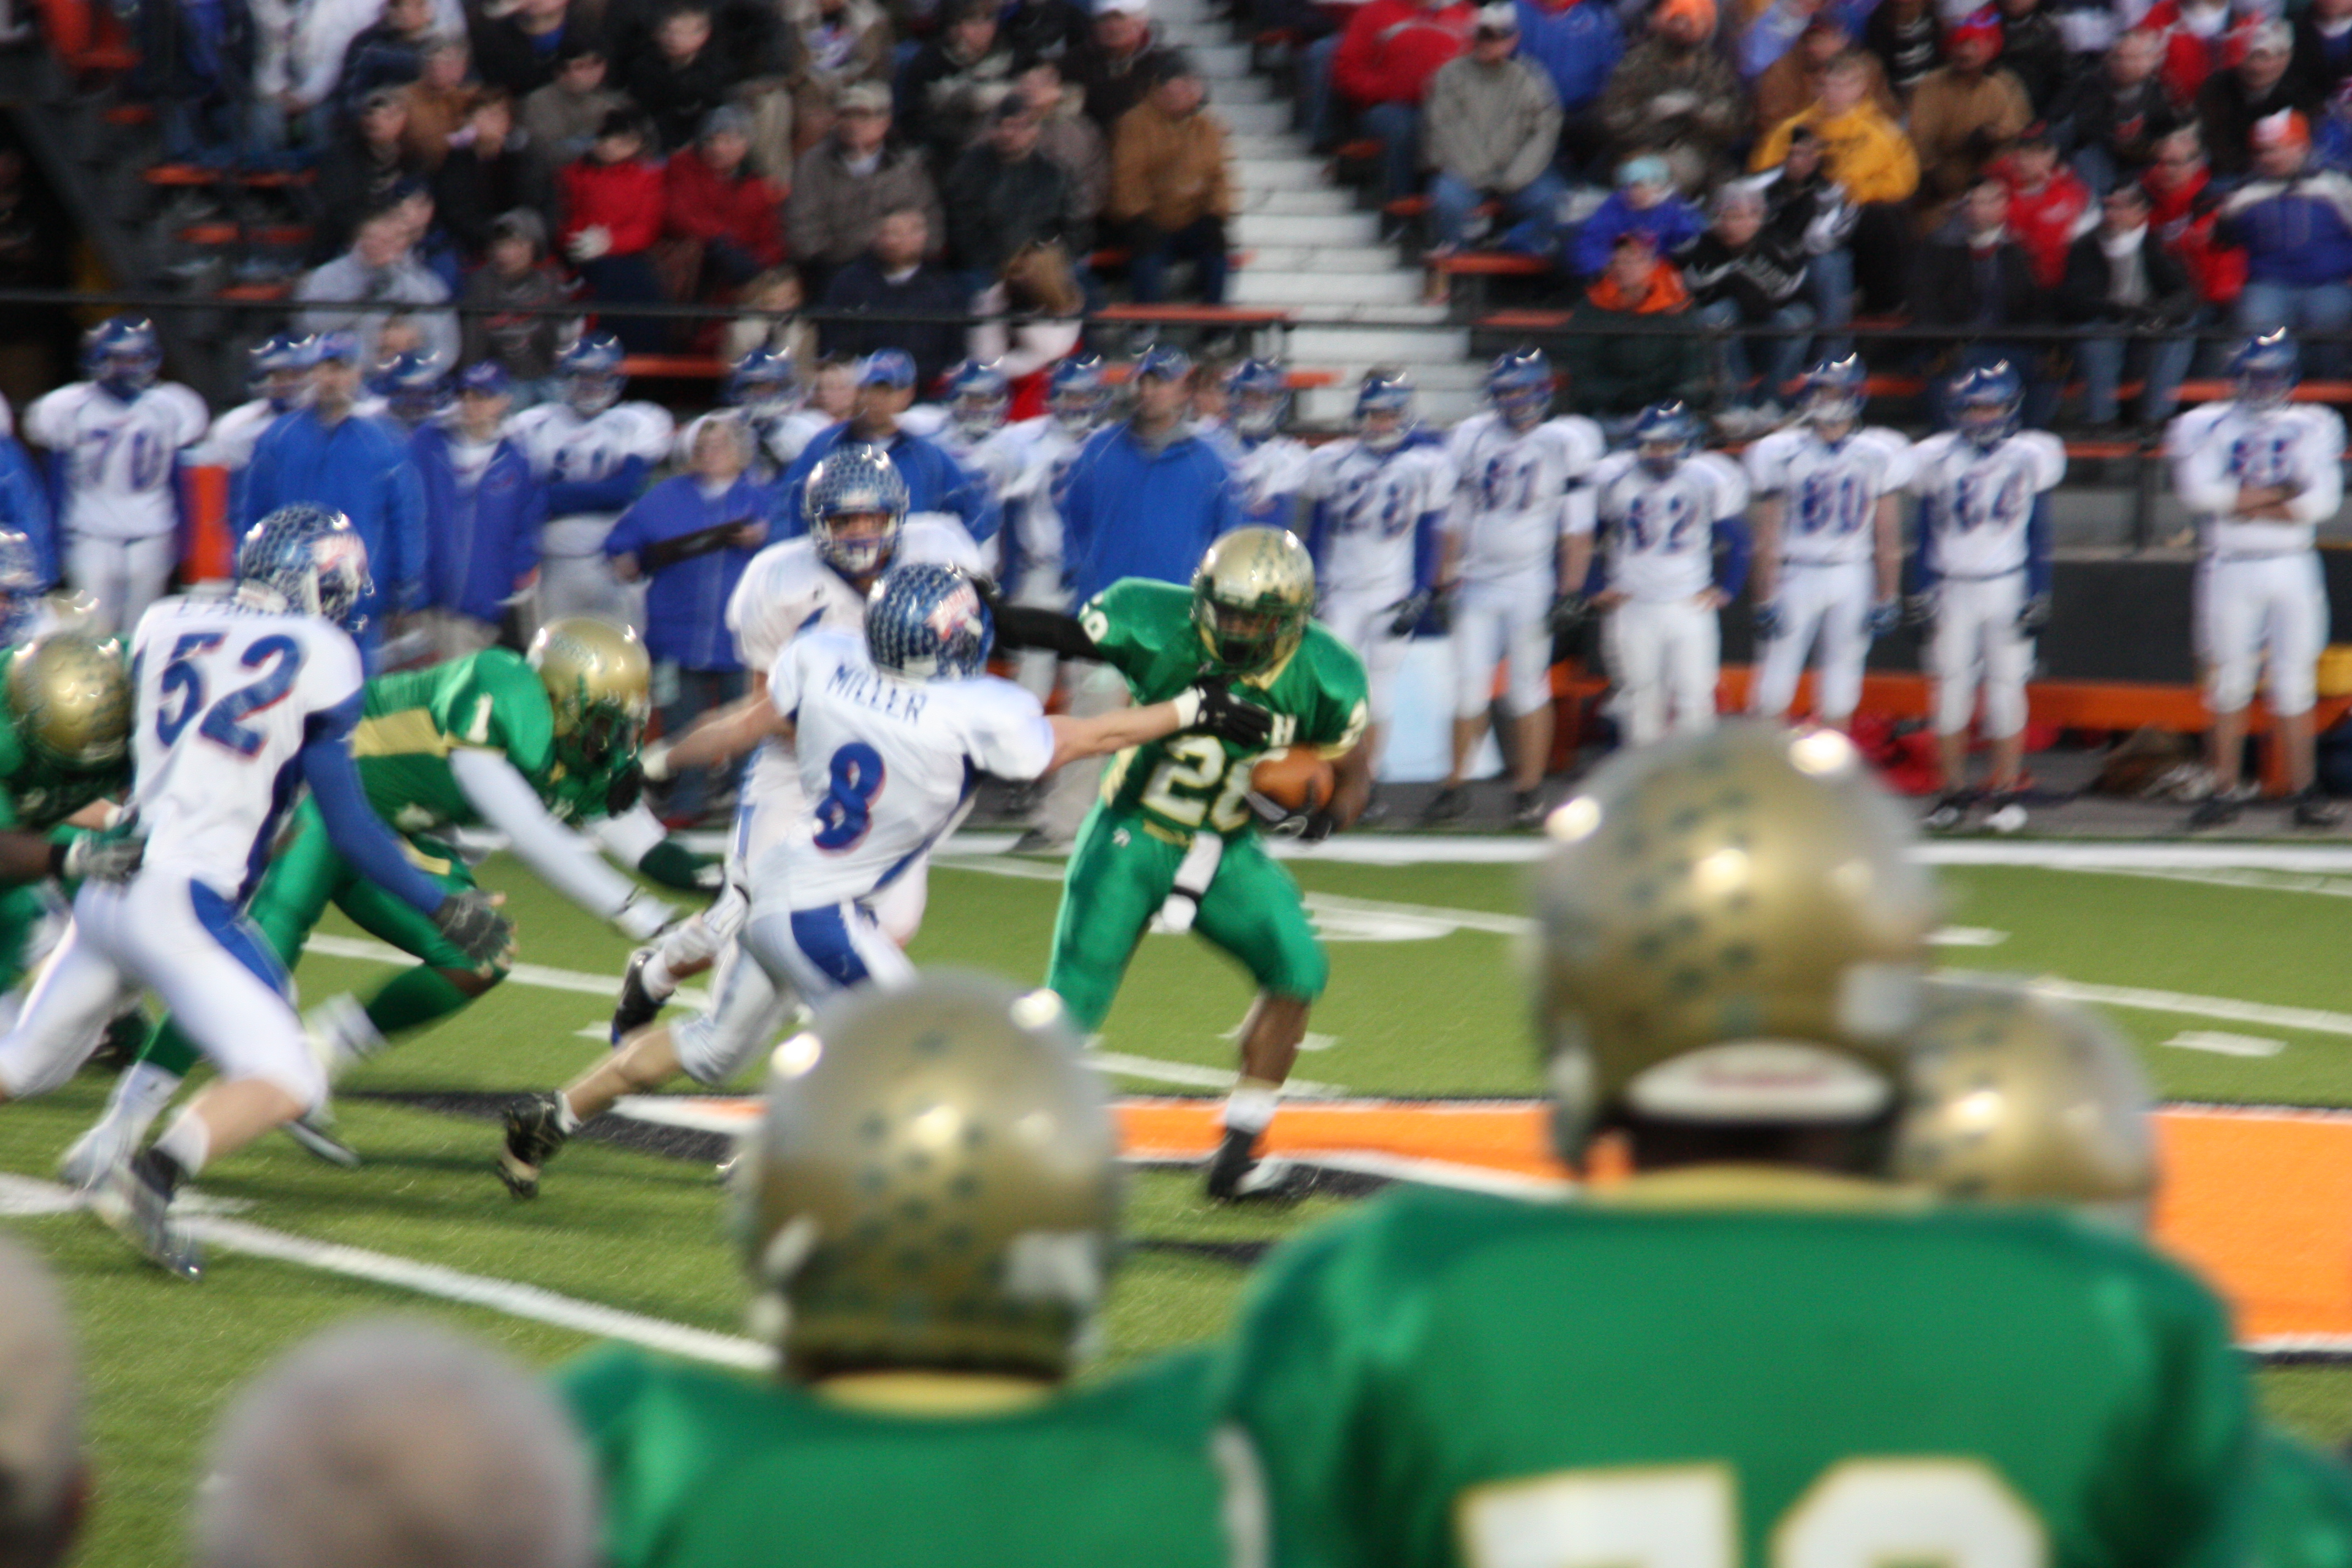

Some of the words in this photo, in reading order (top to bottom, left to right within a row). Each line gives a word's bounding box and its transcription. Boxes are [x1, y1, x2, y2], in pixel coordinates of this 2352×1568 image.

[156, 631, 304, 758] 52
[826, 662, 928, 725] MILLER
[813, 742, 885, 856] 8
